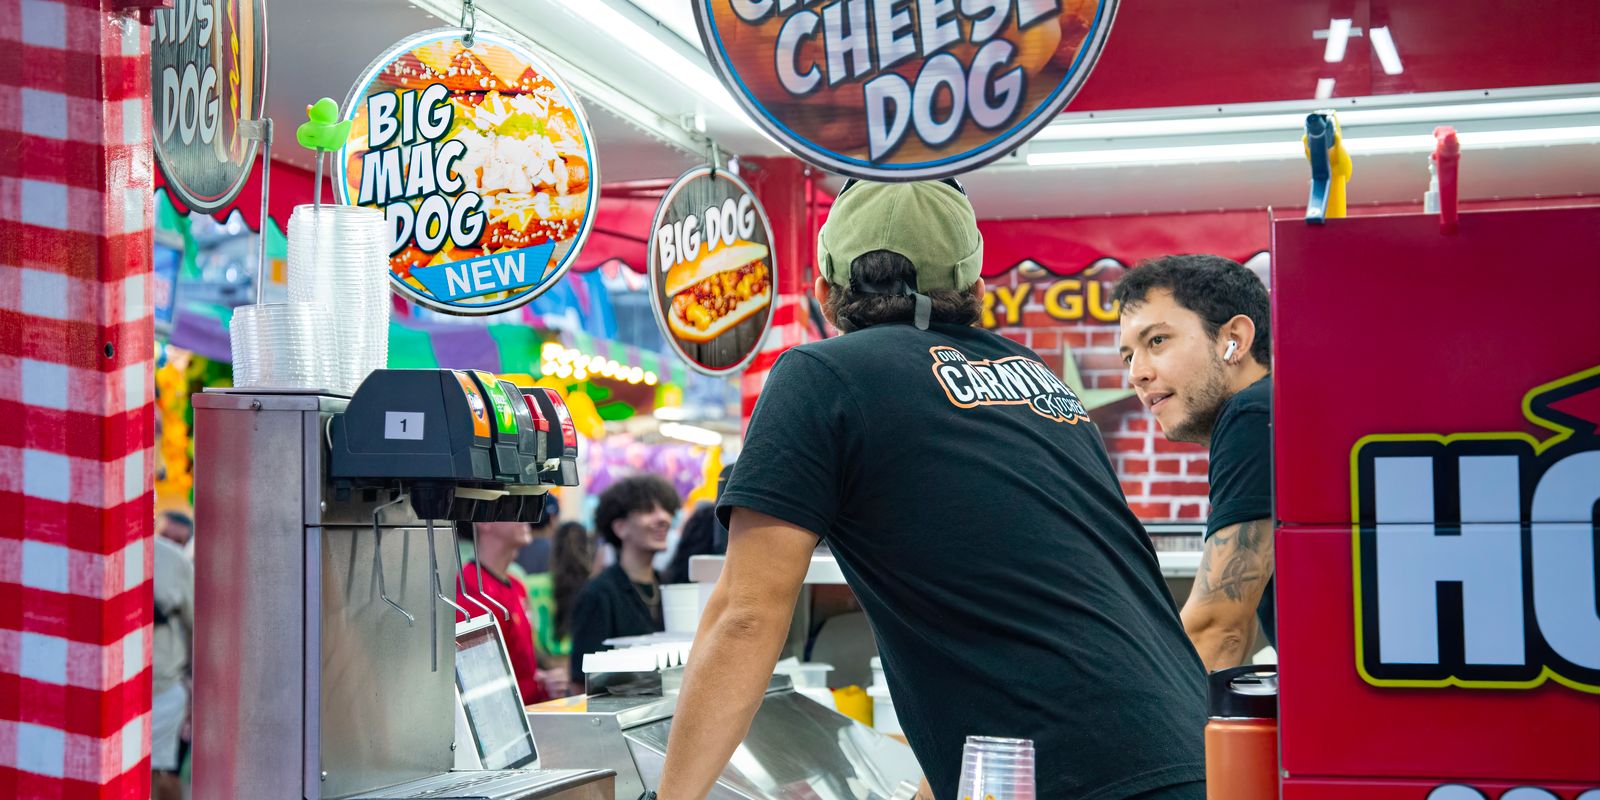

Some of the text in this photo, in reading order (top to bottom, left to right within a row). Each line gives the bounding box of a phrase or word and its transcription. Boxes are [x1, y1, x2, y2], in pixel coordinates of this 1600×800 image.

[163, 64, 219, 145] DOG
[368, 83, 453, 148] BIG
[865, 39, 1024, 162] DOG
[359, 139, 468, 205] MAC
[386, 191, 485, 254] DOG
[658, 194, 756, 272] BIG DOG
[445, 253, 526, 296] NEW
[938, 350, 965, 362] OUR
[400, 418, 407, 432] 1
